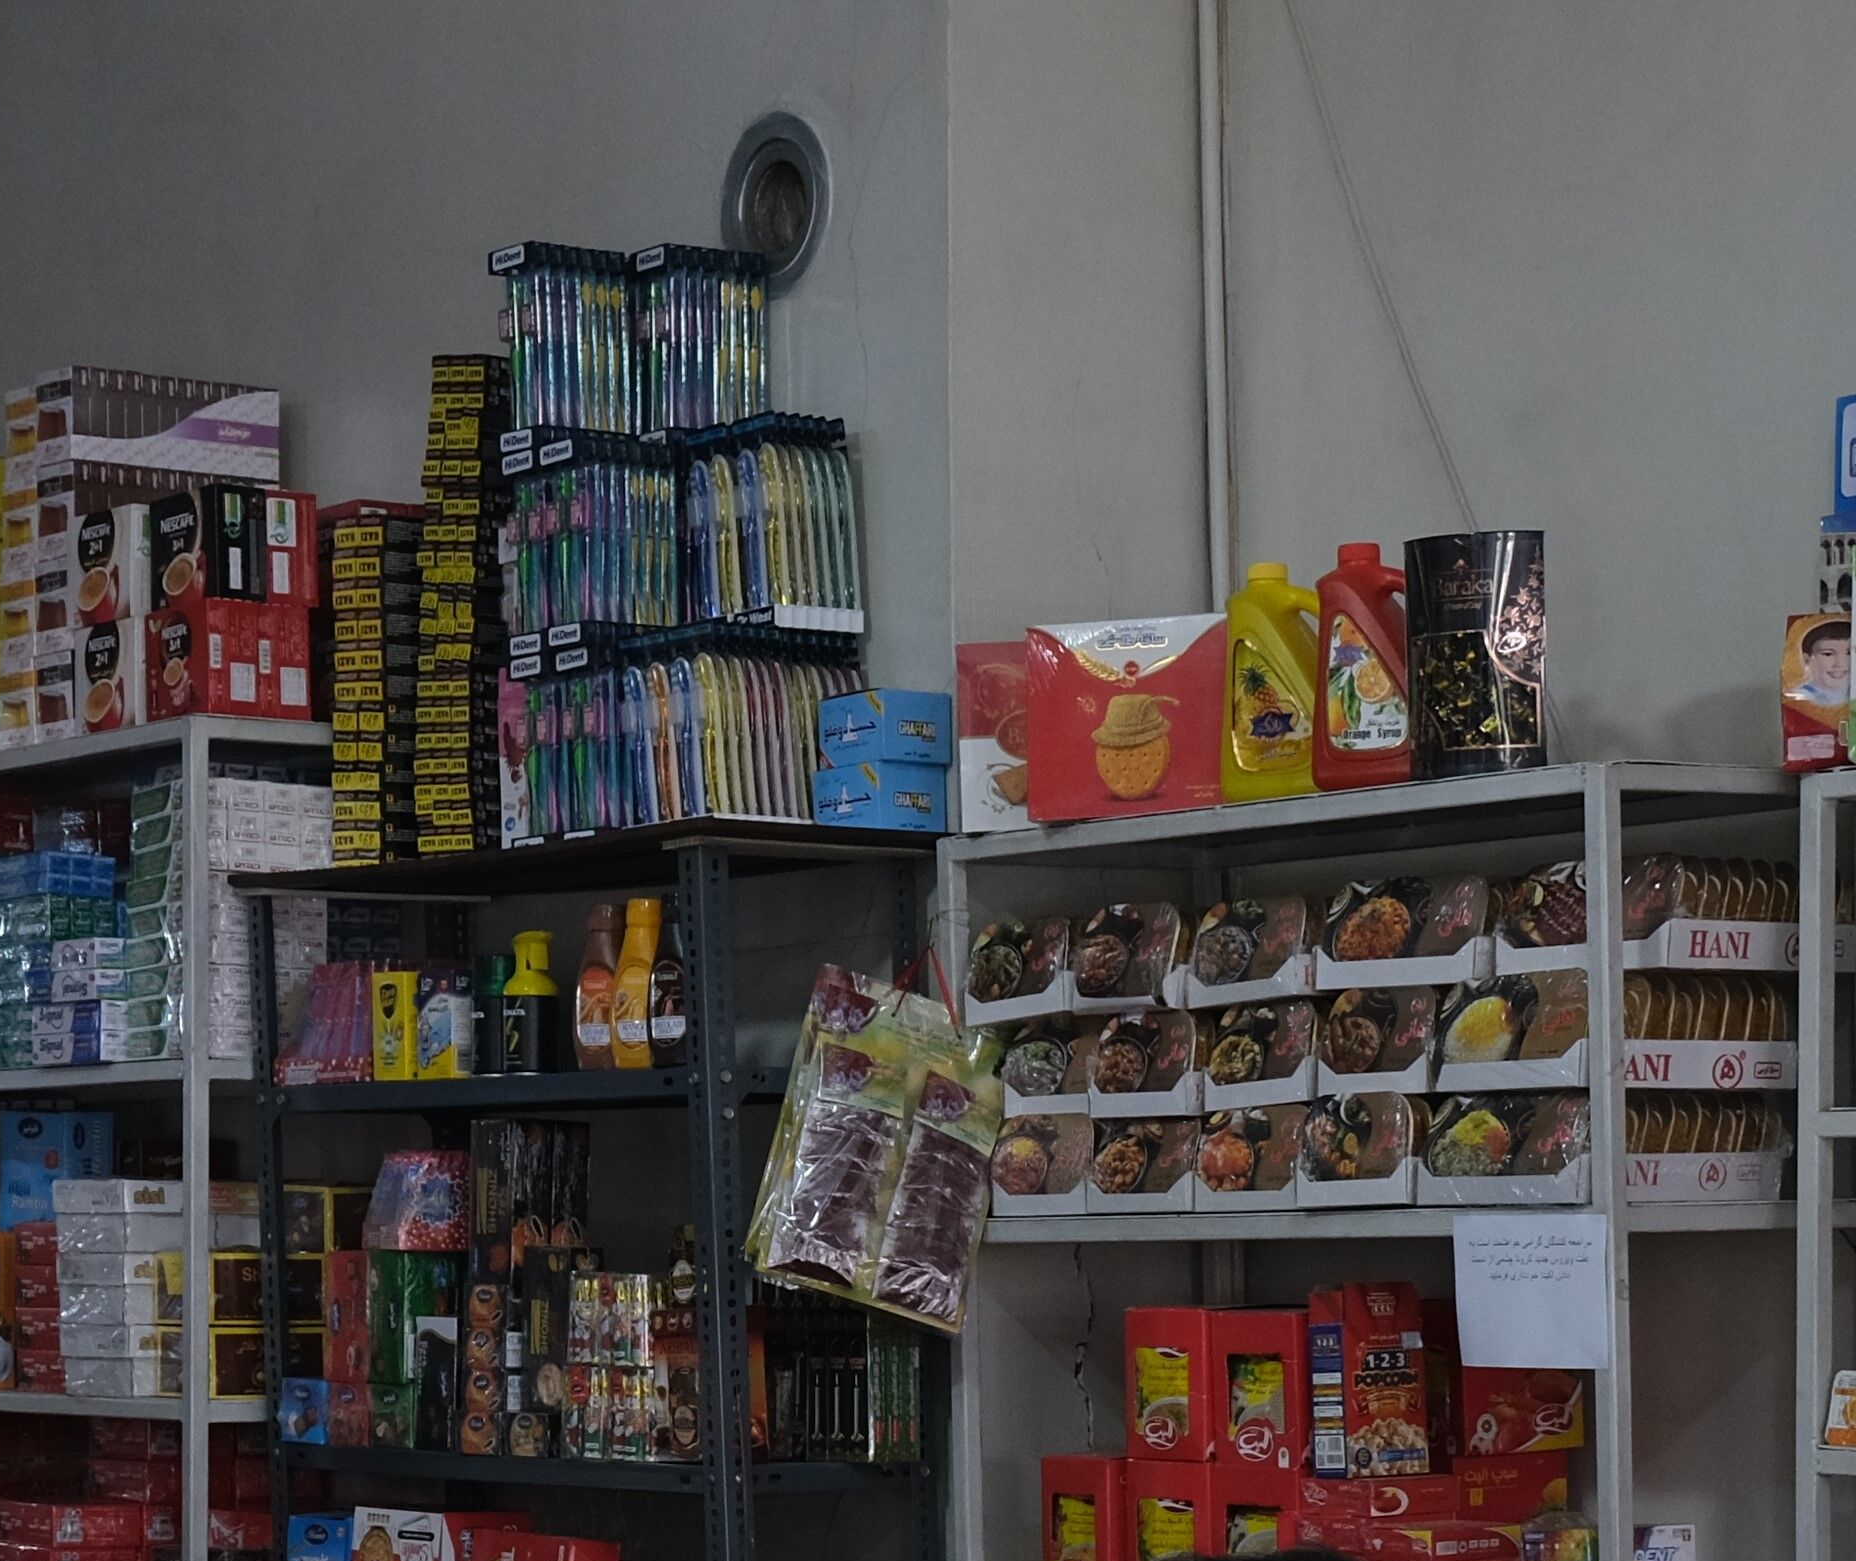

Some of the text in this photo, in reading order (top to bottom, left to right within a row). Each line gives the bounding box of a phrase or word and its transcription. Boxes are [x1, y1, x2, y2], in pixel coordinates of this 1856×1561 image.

[1344, 728, 1403, 741] Orange Syrup
[1689, 930, 1749, 961] HANI
[1625, 1054, 1671, 1083] ANI
[1353, 1372, 1420, 1388] POPCORN
